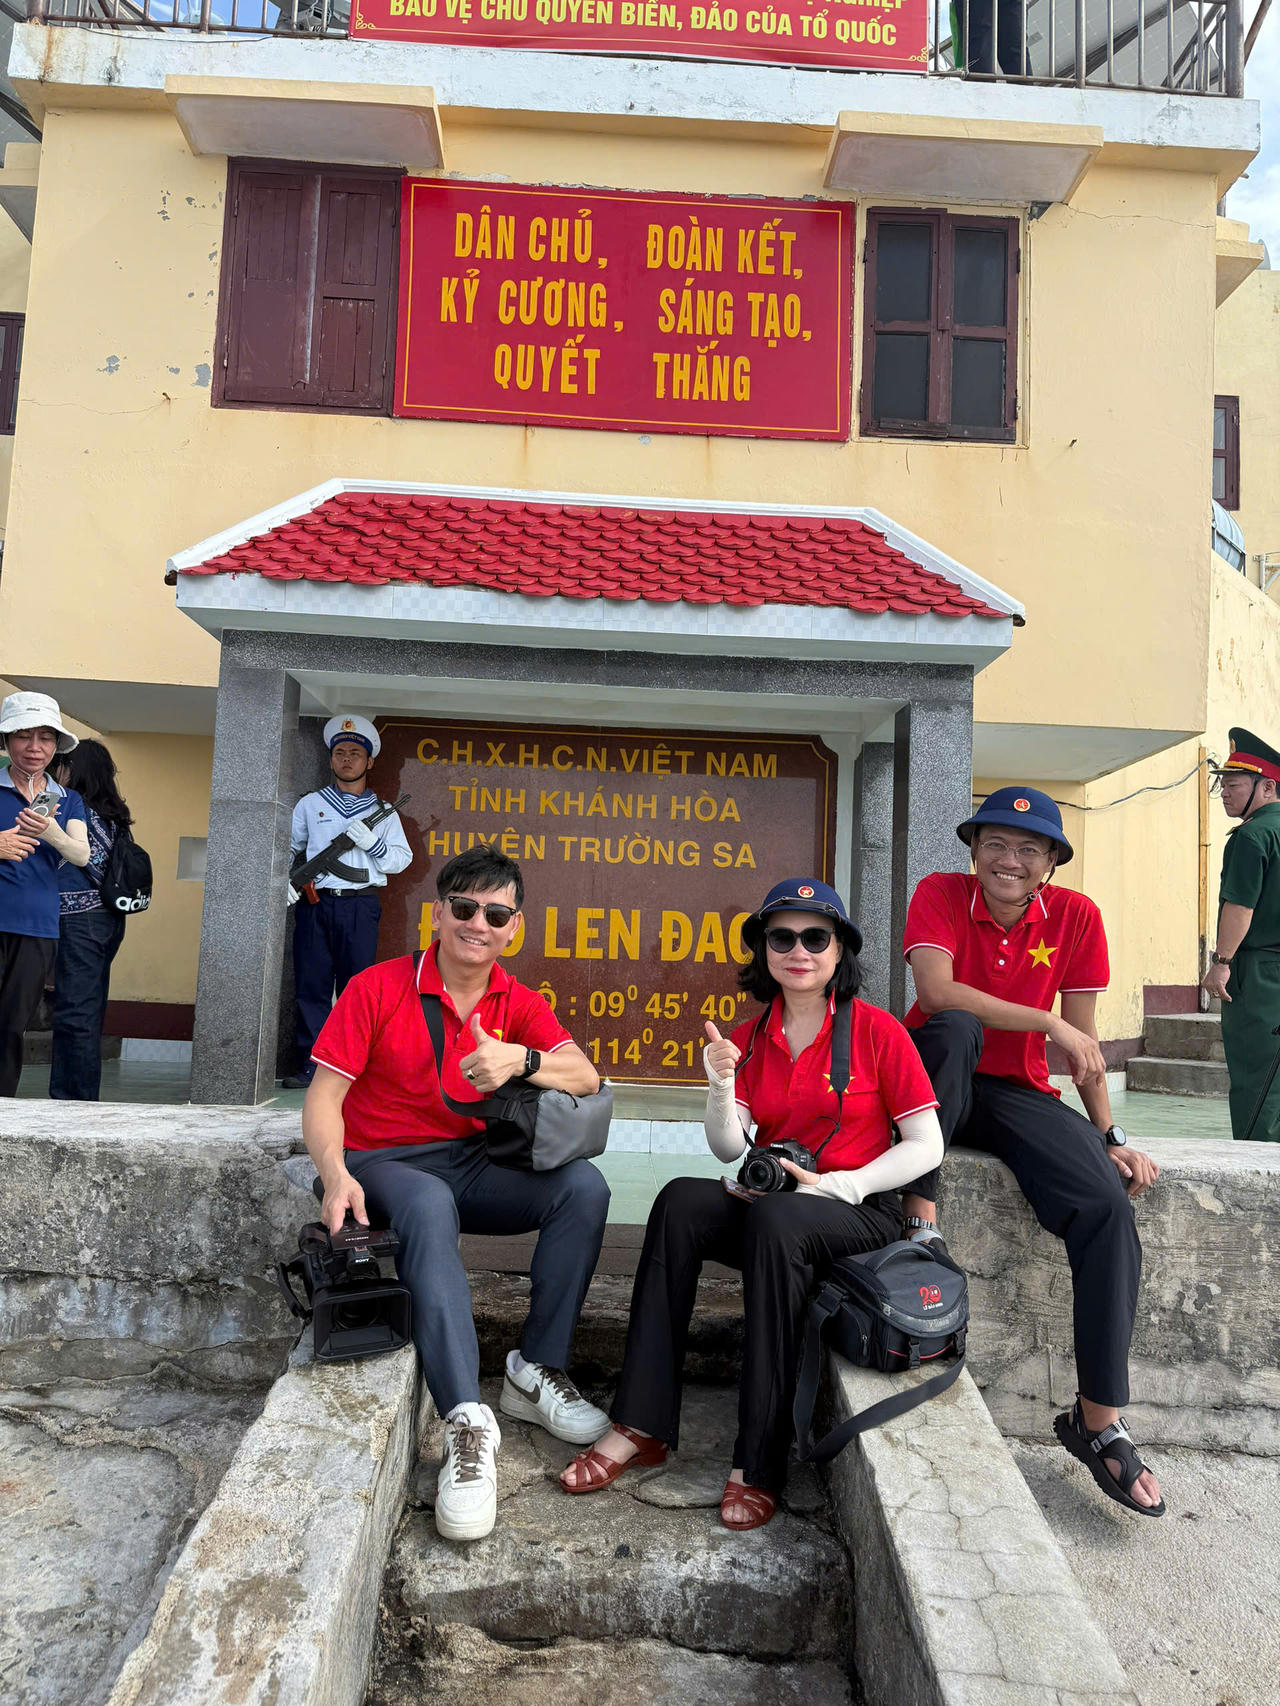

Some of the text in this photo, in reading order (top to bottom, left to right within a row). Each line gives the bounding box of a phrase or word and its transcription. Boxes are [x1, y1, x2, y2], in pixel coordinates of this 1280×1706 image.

[690, 6, 736, 31] ĐẢO
[746, 7, 790, 34] CỦA
[800, 15, 825, 38] TỔ
[835, 20, 895, 44] QUỐC
[455, 206, 802, 279] DÂN CHỦ, ĐOÀN KẾT,
[441, 269, 811, 347] KỶ CƯƠNG, SÁNG TẠO,
[494, 335, 749, 401] QUYẾT THẮNG
[707, 752, 776, 778] NAM
[448, 777, 740, 822] TỈNH KHÁNH HÒA
[556, 832, 700, 866] TRƯỜNG
[712, 842, 756, 869] SA
[544, 907, 640, 960] LEN
